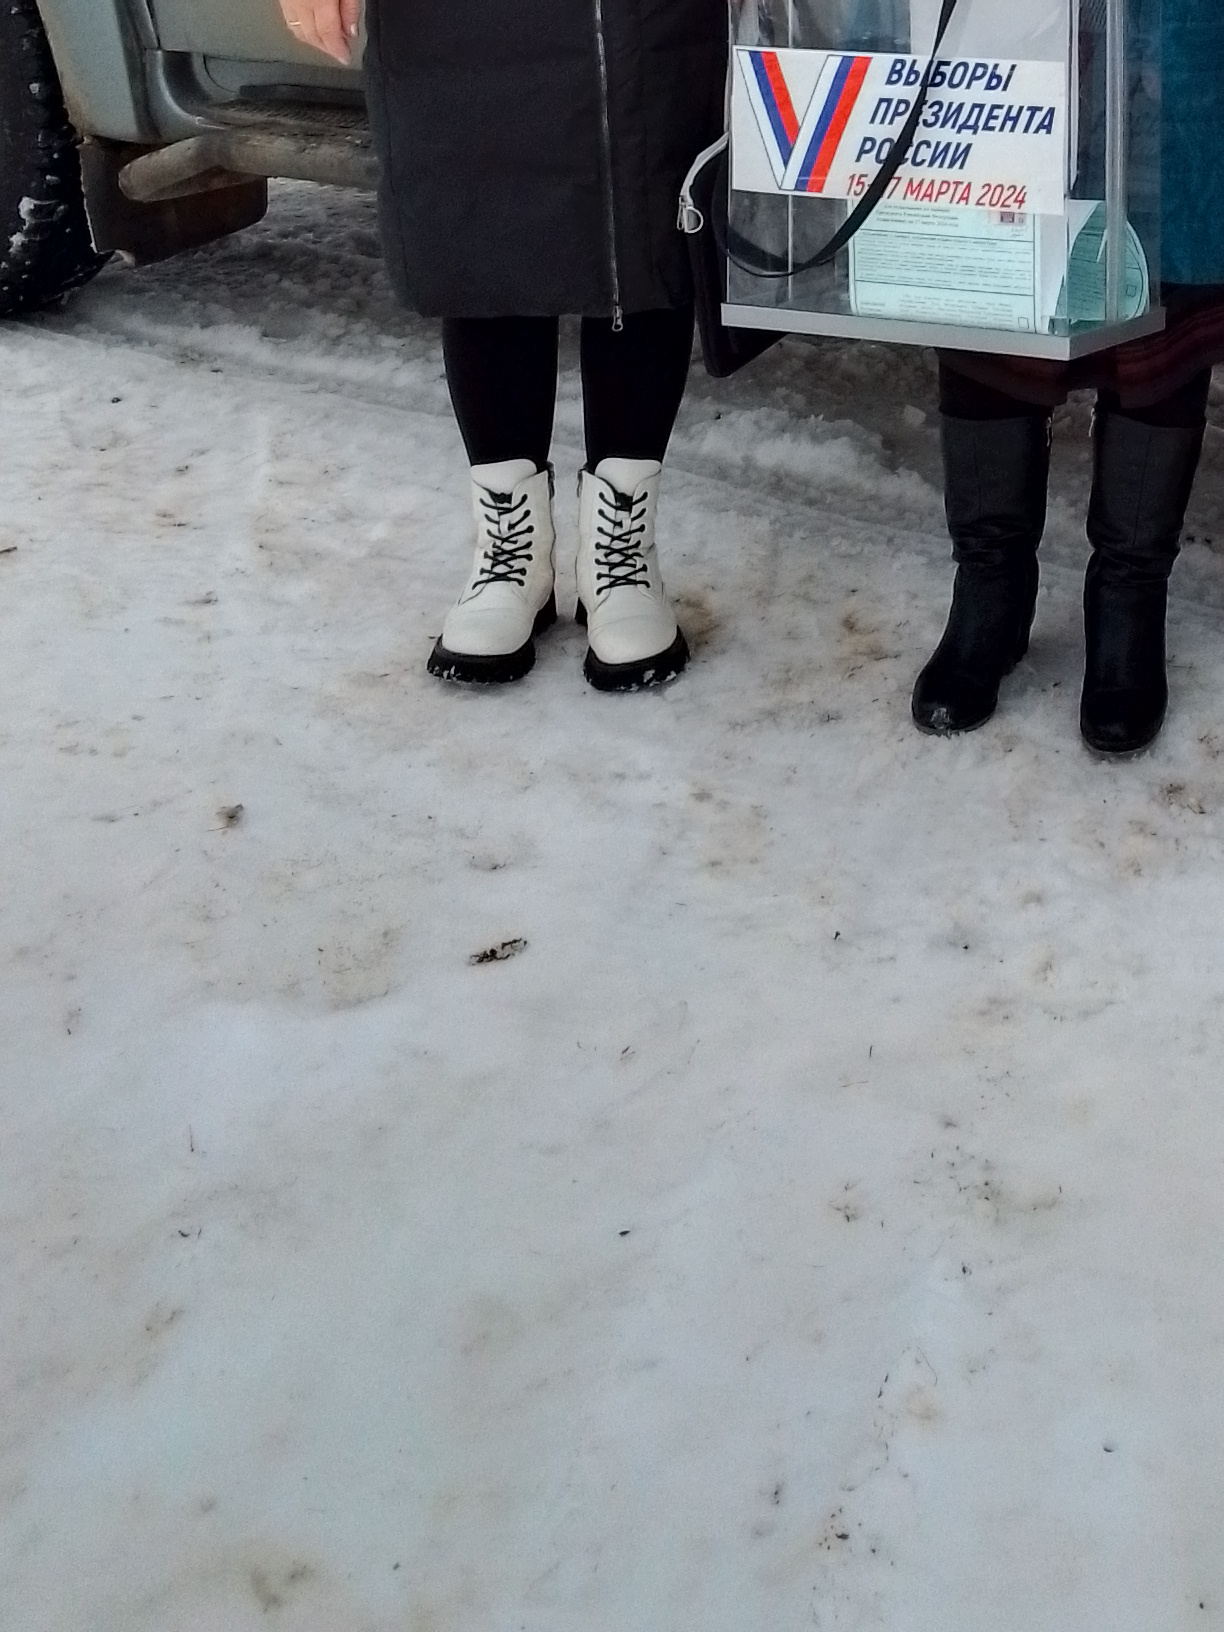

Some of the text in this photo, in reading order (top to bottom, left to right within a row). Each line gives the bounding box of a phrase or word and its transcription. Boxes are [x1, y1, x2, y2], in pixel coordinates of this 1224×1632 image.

[869, 97, 1056, 135] ПРЗИДЕНТА
[855, 136, 973, 170] РОСИИ
[846, 173, 1027, 209] 15-7 МАРТА 2024
